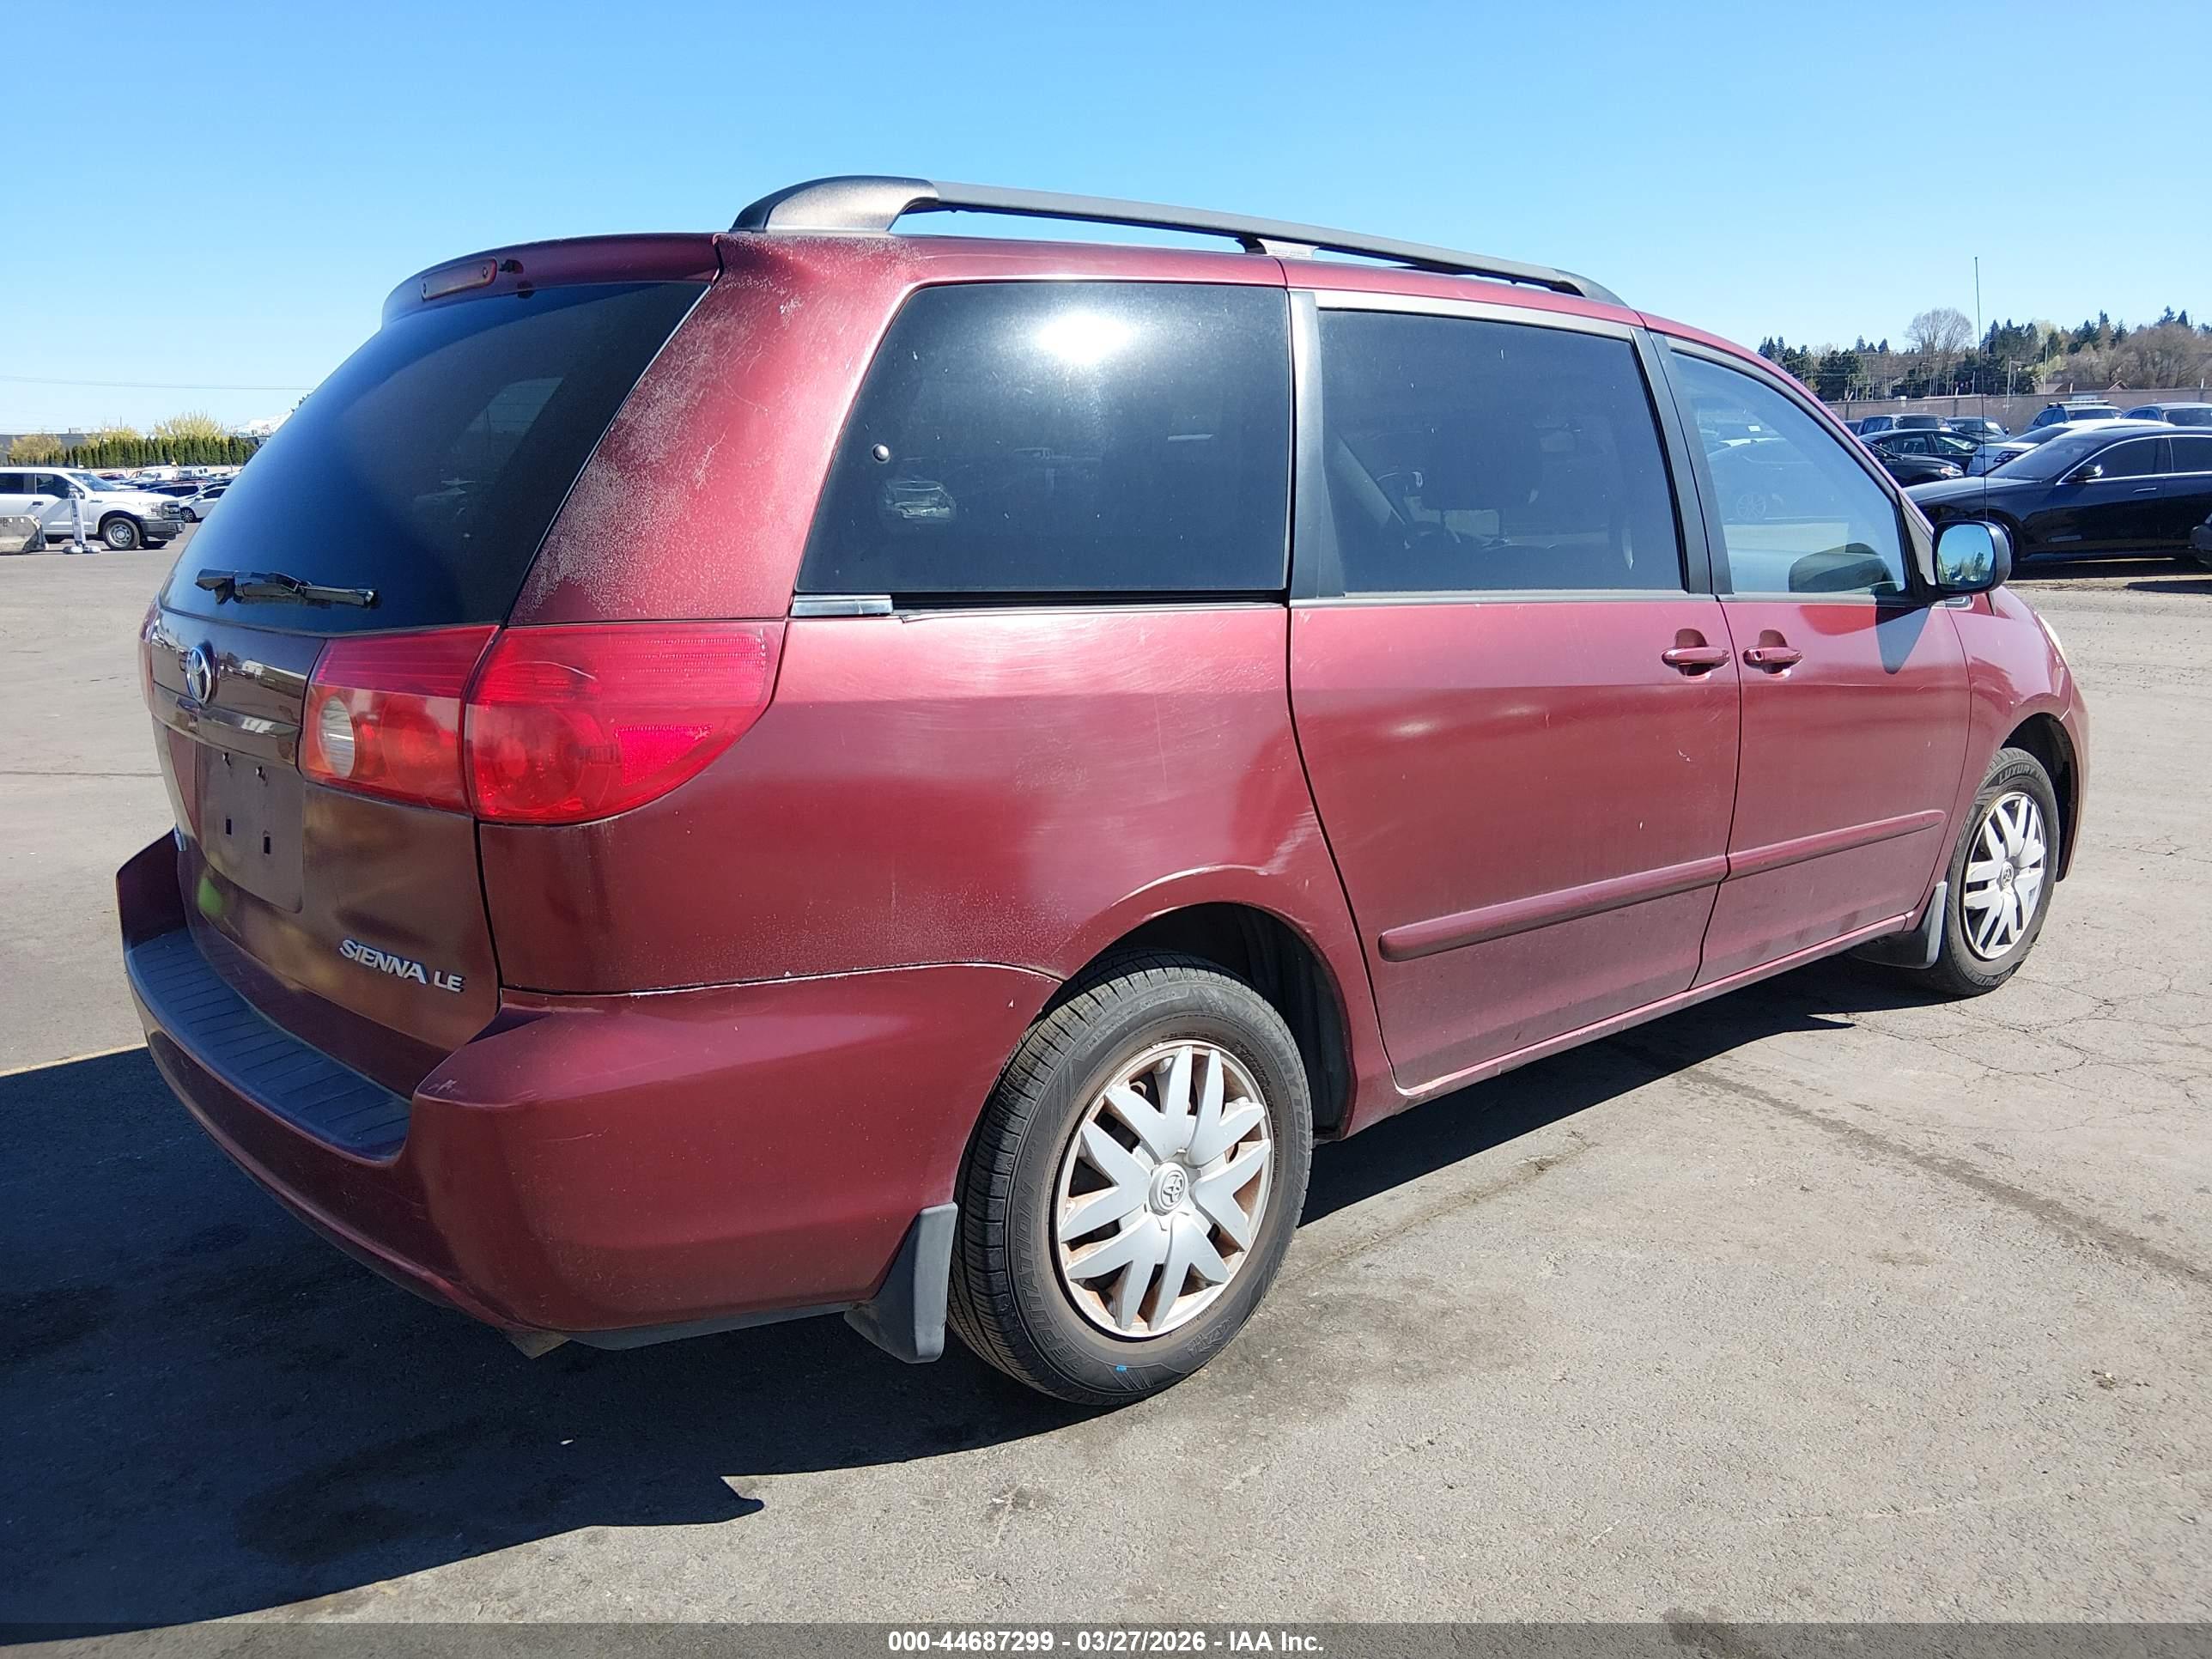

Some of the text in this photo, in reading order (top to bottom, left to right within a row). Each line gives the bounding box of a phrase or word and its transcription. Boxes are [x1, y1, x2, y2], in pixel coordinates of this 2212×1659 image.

[1998, 763, 2035, 785] LUXURY
[339, 939, 464, 993] SIENNA LE
